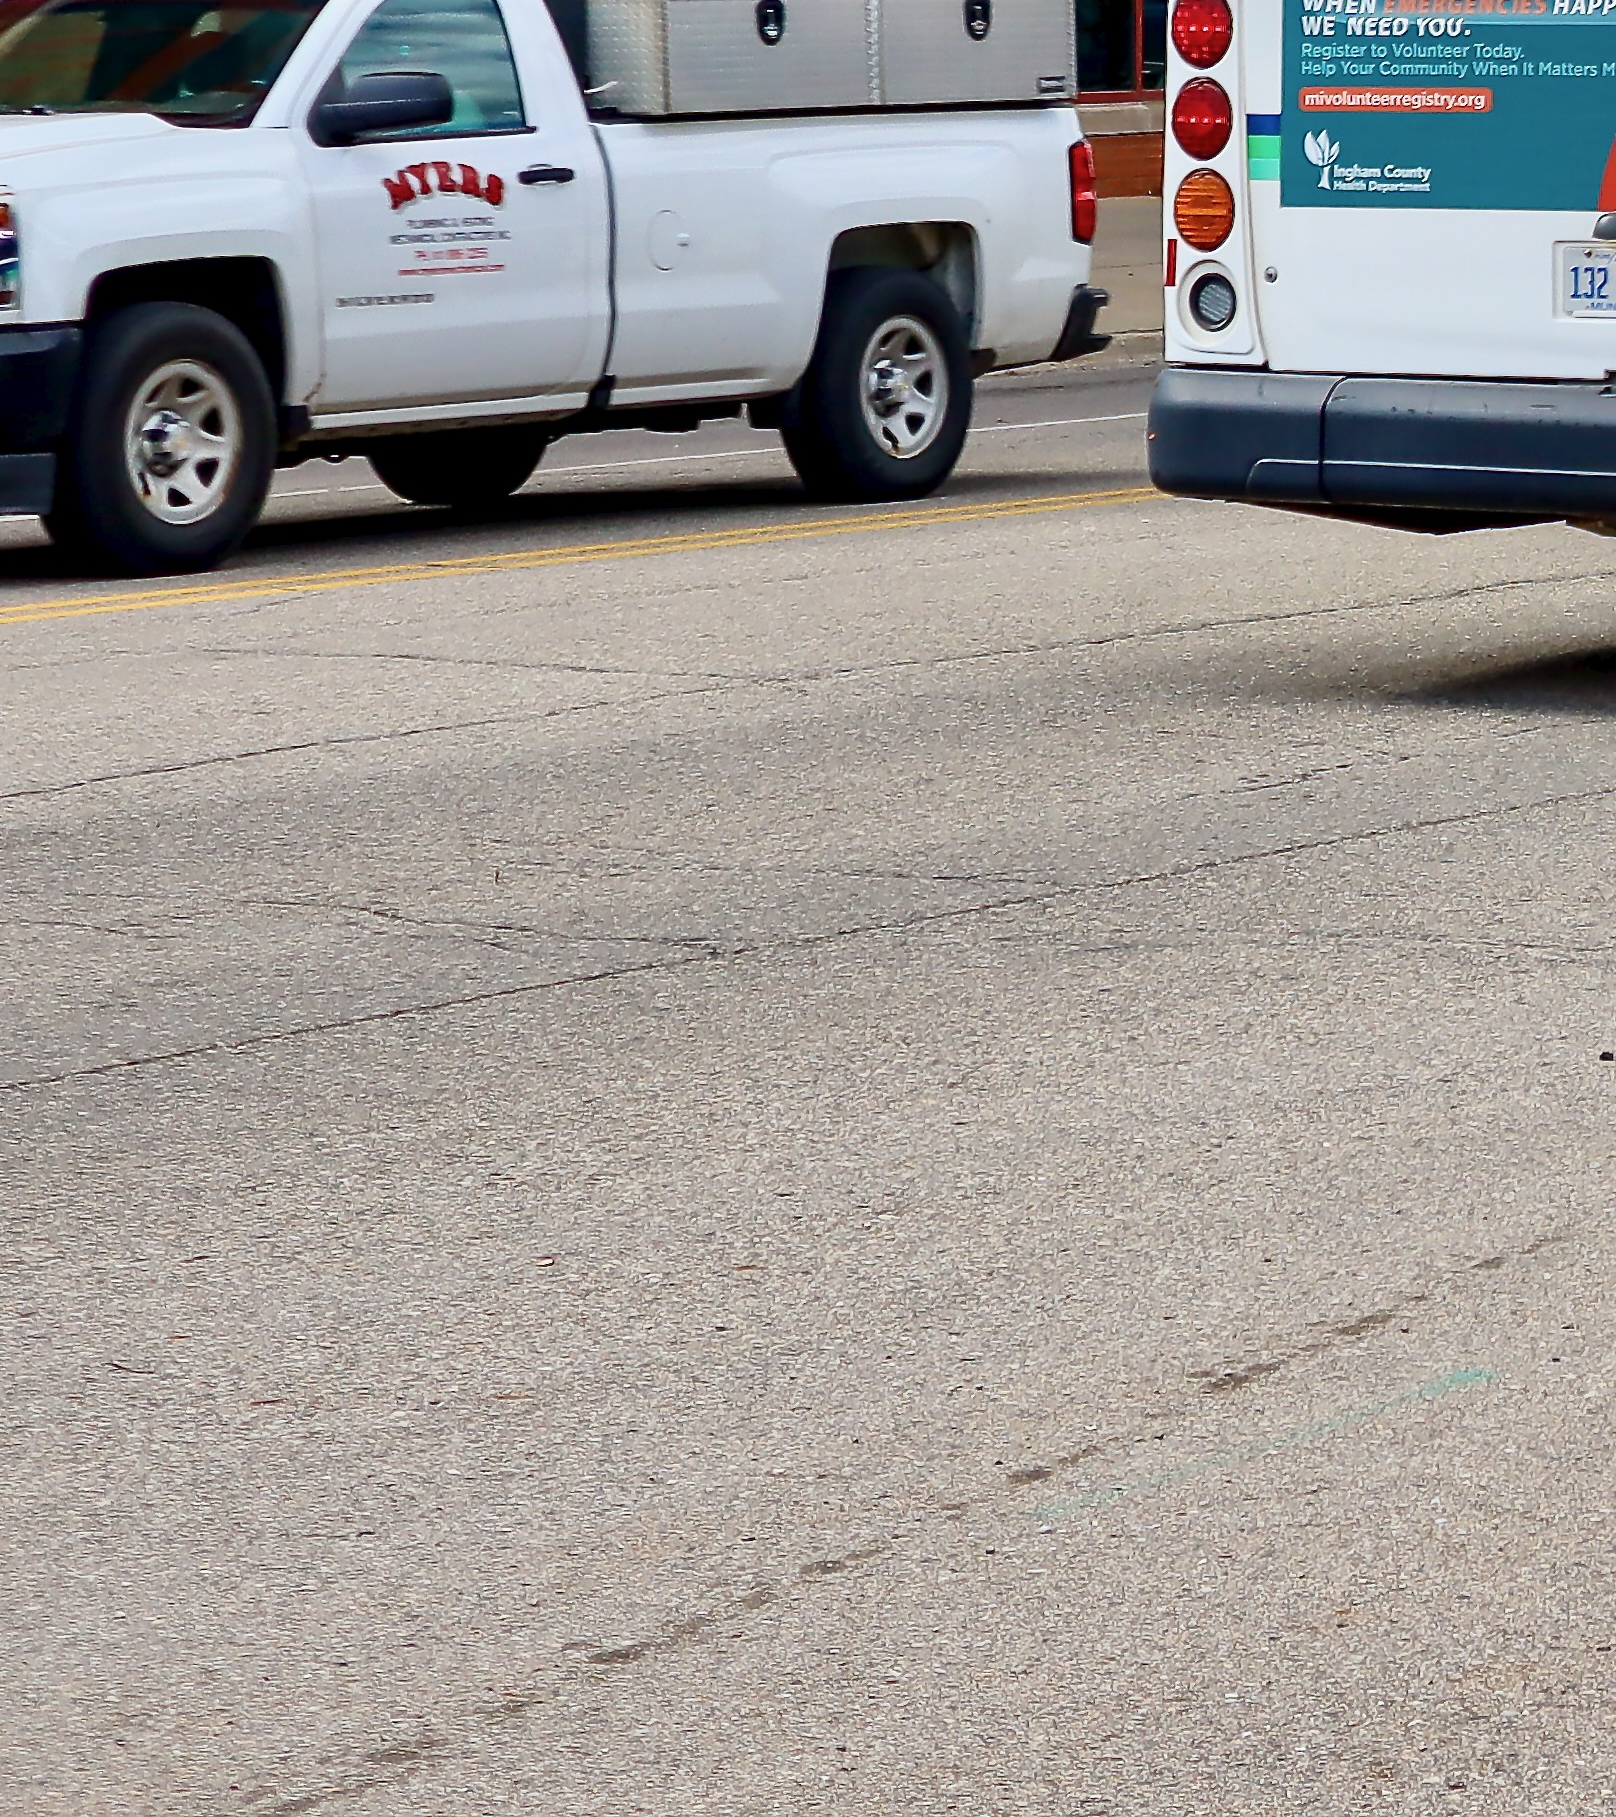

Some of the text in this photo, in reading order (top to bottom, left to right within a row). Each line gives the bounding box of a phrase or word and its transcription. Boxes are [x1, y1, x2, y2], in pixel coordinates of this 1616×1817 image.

[1301, 16, 1471, 37] WE NEED YOU.
[1301, 43, 1525, 61] Register to Volunteer Today.
[1301, 62, 1336, 79] Help
[1340, 62, 1375, 76] Your
[1378, 61, 1468, 79] Community
[1472, 62, 1518, 77] When
[1523, 62, 1535, 77] It
[1538, 62, 1598, 77] Matters
[1304, 91, 1486, 110] mivolunteerregistry.org
[1332, 164, 1432, 183] Ingham County
[382, 161, 505, 211] MYERS
[1333, 180, 1431, 193] Health Department
[1570, 266, 1610, 299] 132
